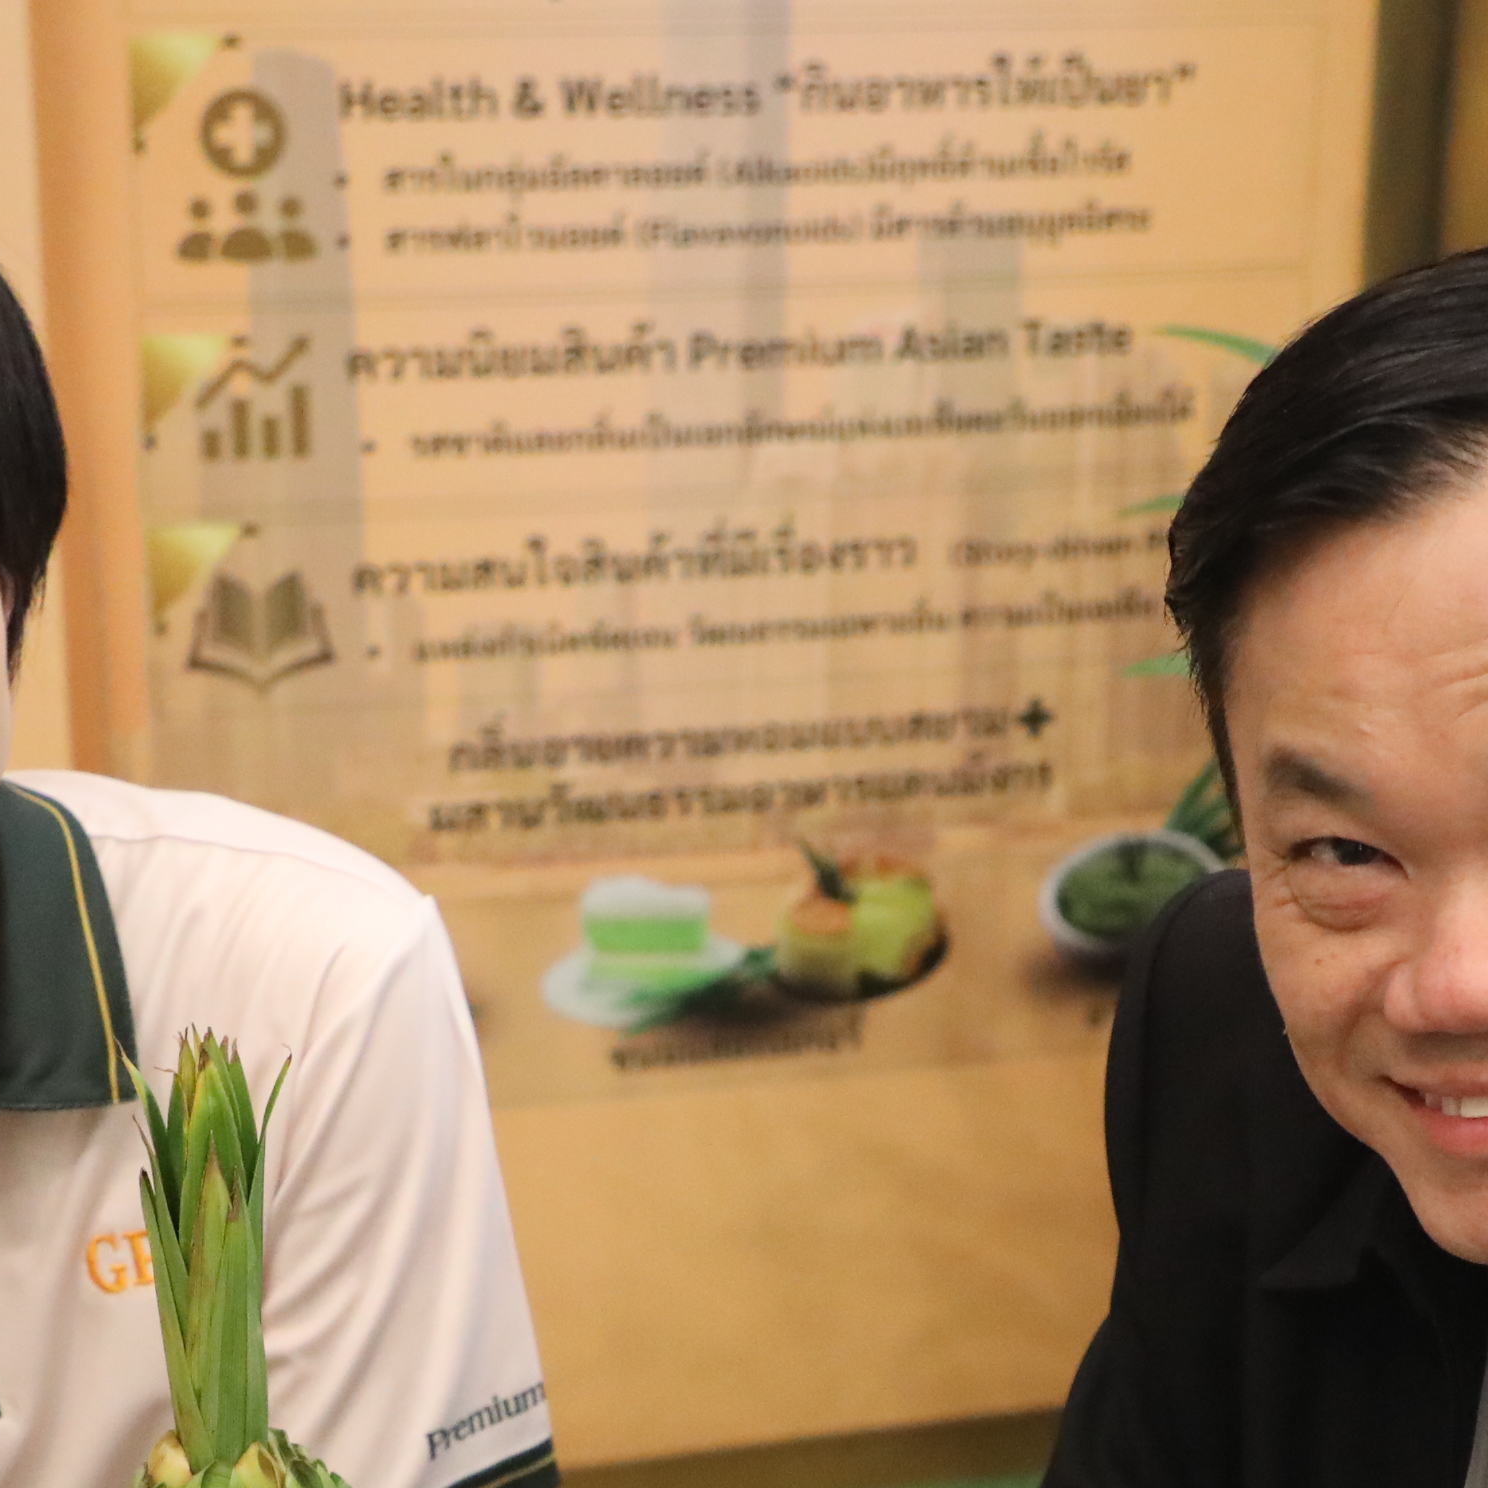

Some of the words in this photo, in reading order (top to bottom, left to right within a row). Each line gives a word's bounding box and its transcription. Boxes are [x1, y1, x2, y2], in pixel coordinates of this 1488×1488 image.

[340, 73, 499, 121] Health
[514, 73, 544, 118] &
[560, 70, 761, 117] Wellness
[688, 330, 884, 371] Premium
[894, 326, 1011, 362] Asian
[1021, 317, 1132, 356] Taste
[426, 1381, 546, 1460] Premium
